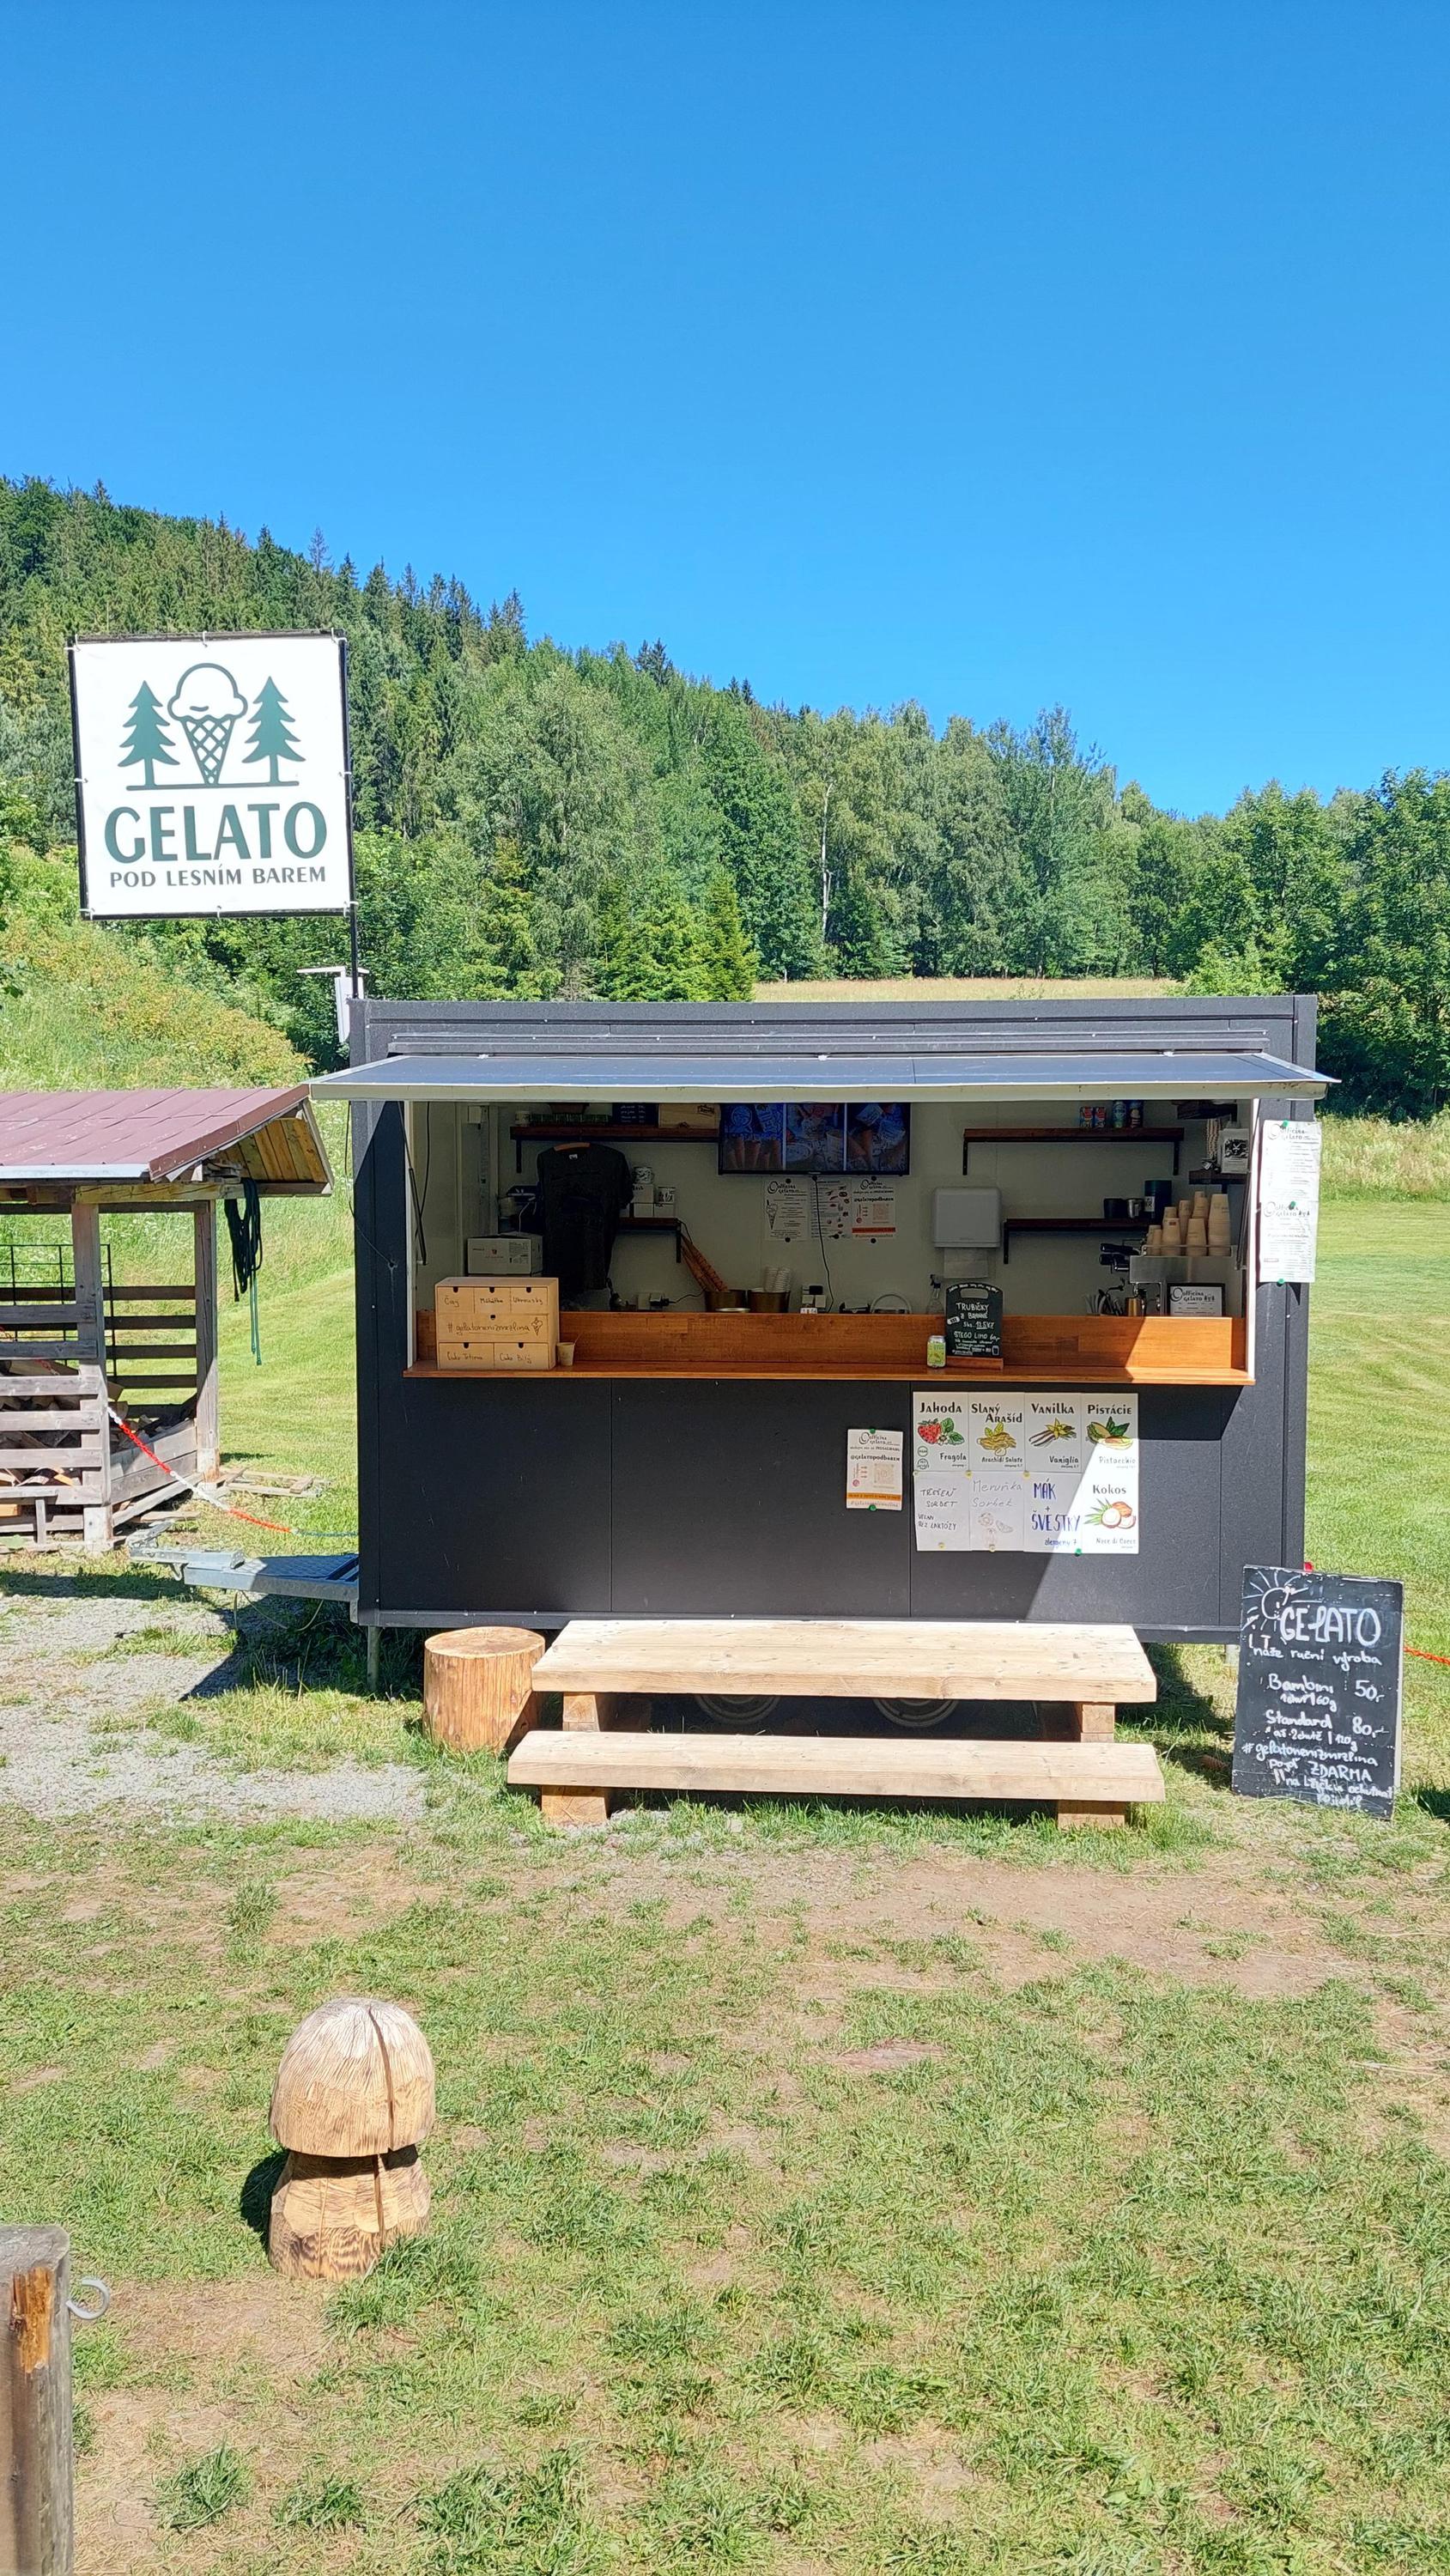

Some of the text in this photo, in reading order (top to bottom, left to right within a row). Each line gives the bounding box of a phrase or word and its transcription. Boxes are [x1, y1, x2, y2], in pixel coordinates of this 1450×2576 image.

[104, 801, 327, 864] GELATO
[110, 863, 326, 888] POD LESNÍM BAREM
[956, 1302, 989, 1314] TRUBIČKY
[919, 1401, 962, 1413] Jahoda
[971, 1403, 1000, 1415] Slaný
[1031, 1402, 1075, 1414] Vanilka
[1087, 1404, 1132, 1415] Pistácie
[985, 1413, 1022, 1423] Arašíd
[939, 1452, 967, 1462] Fragola
[1049, 1455, 1079, 1466] Vaniglia
[1034, 1478, 1057, 1500] MÁK
[1092, 1484, 1127, 1494] Kokos
[1031, 1510, 1081, 1532] ŠVESTKY
[1279, 1606, 1381, 1648] GELATO
[1253, 1647, 1383, 1672] naše ruční výroba
[1268, 1673, 1333, 1694] Bambini
[1265, 1709, 1333, 1729] Standard
[1307, 1760, 1373, 1783] ZDARMA
